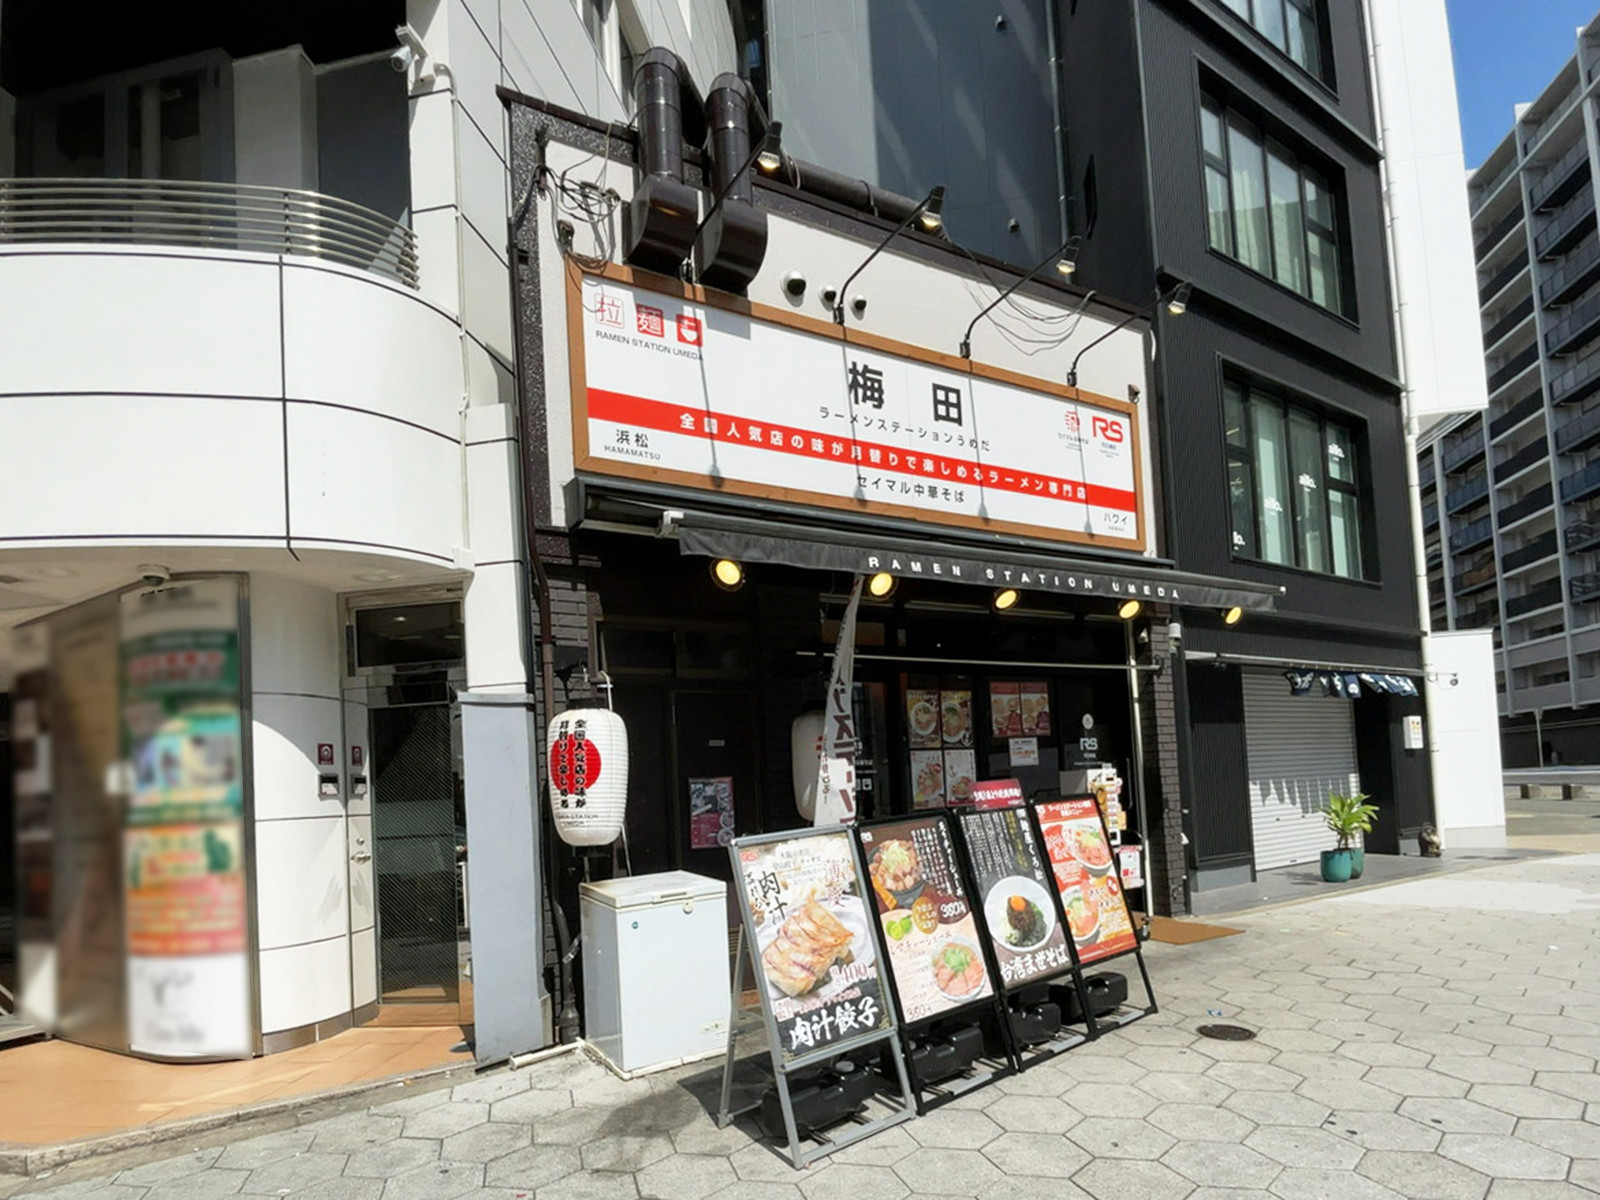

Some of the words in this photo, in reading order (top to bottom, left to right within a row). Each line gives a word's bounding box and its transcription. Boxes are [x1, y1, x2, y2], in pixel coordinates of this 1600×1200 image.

[595, 330, 630, 345] RAMEN
[631, 338, 671, 354] STATION
[672, 347, 704, 361] UMEDA
[848, 361, 963, 427] 梅田
[616, 429, 649, 448] 浜松
[819, 406, 990, 451] ラーメンステーションうめだ
[1092, 416, 1124, 443] RS
[604, 445, 661, 460] HAMAMATSU
[856, 474, 965, 503] セイマル中華そば
[1103, 513, 1128, 525] ハワイ
[868, 556, 961, 577] RAMEN
[986, 568, 1093, 590] STATION
[1112, 582, 1179, 599] UMEDA
[1001, 944, 1069, 982] 台湾まぜそば
[789, 996, 878, 1050] 肉汁餃子
